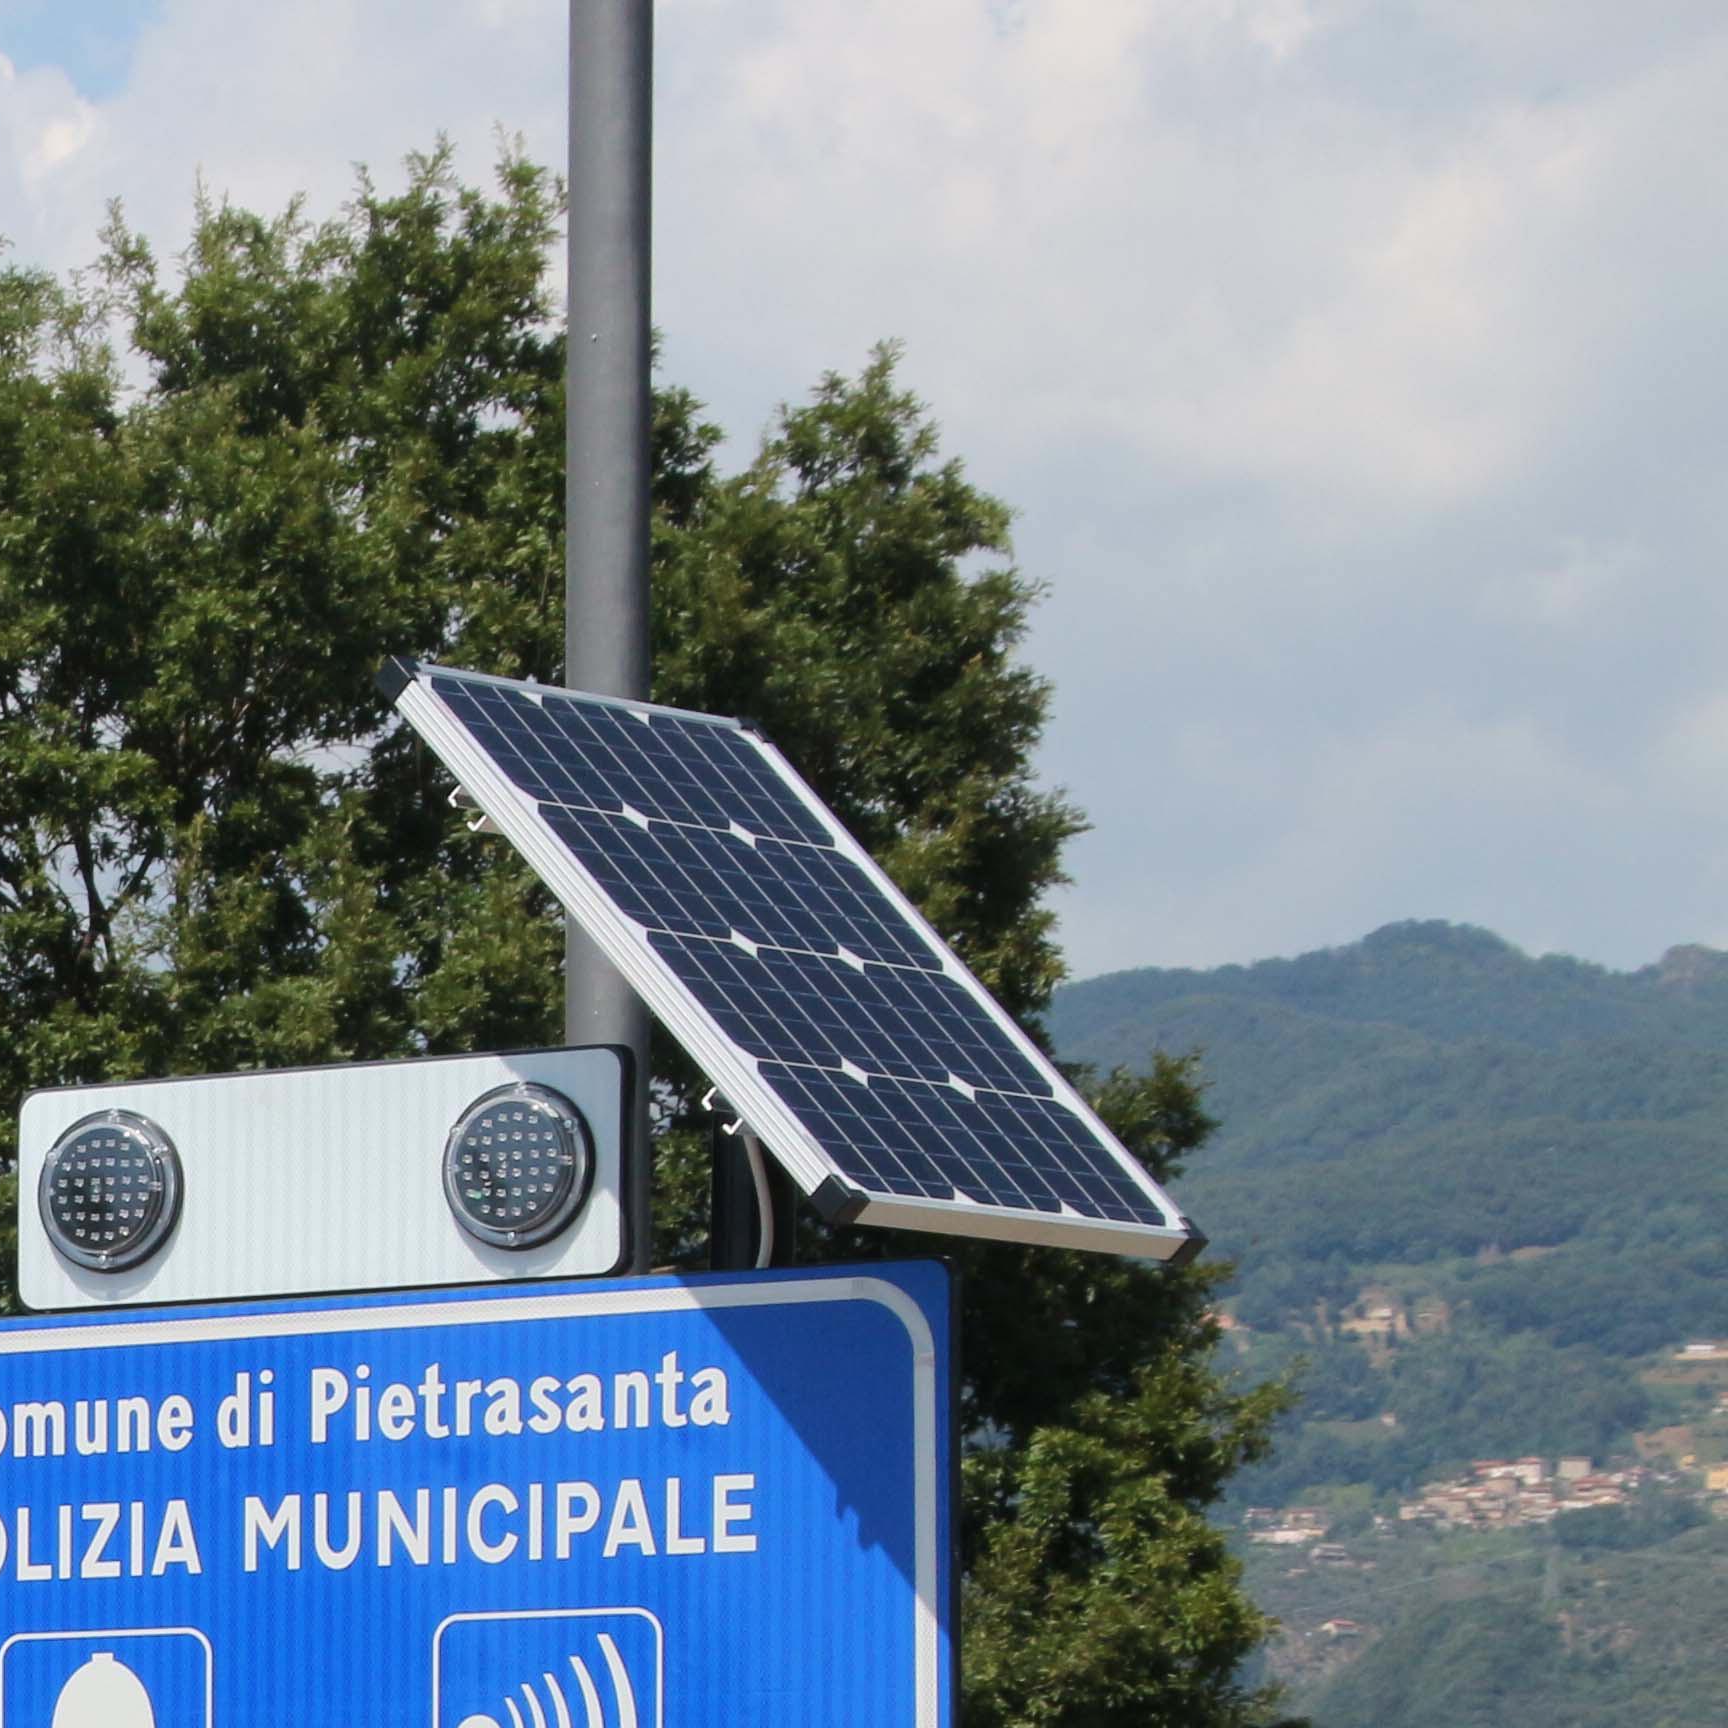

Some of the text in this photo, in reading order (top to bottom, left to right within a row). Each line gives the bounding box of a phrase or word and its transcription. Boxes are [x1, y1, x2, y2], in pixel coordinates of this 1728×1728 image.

[216, 1369, 274, 1448] di
[311, 1351, 731, 1443] Pietrasanta
[244, 1473, 758, 1572] MUNICIPALE
